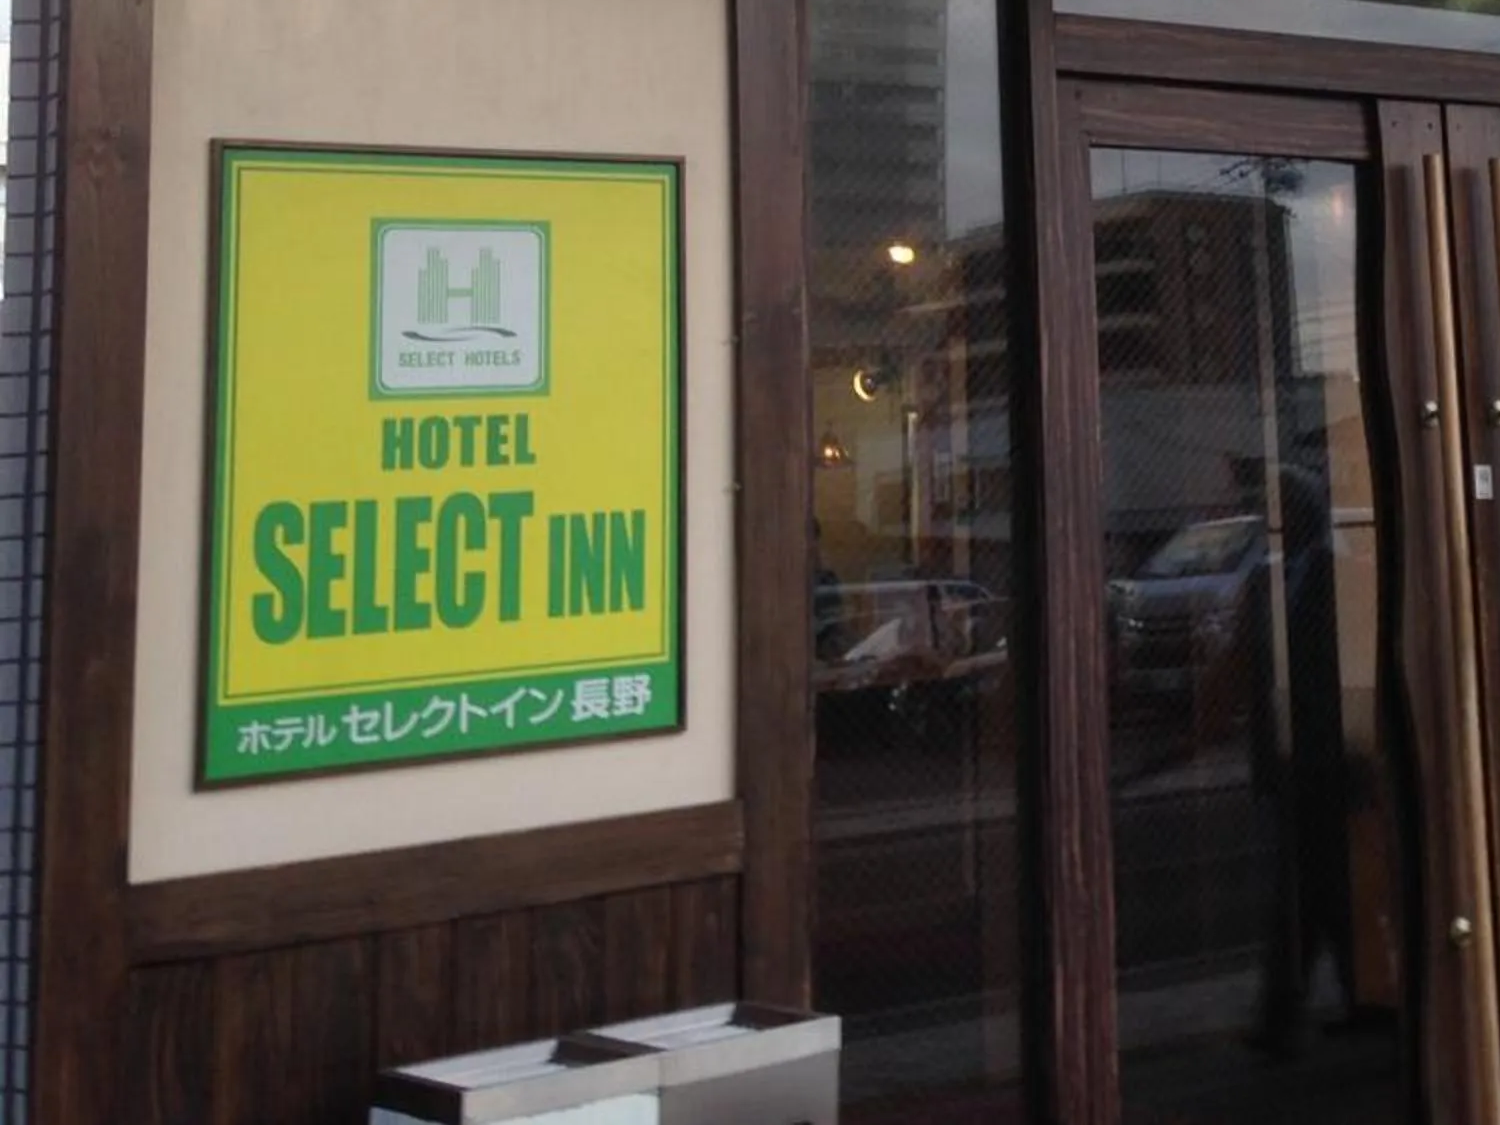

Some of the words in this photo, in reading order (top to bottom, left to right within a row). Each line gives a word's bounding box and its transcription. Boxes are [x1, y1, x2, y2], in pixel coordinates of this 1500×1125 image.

[398, 351, 456, 369] SELECT
[464, 349, 522, 367] HOTELS
[380, 413, 537, 473] HOTEL
[251, 490, 535, 646] SELECT
[547, 509, 647, 620] INN
[236, 673, 653, 756] ホテルセレクトイン長野
